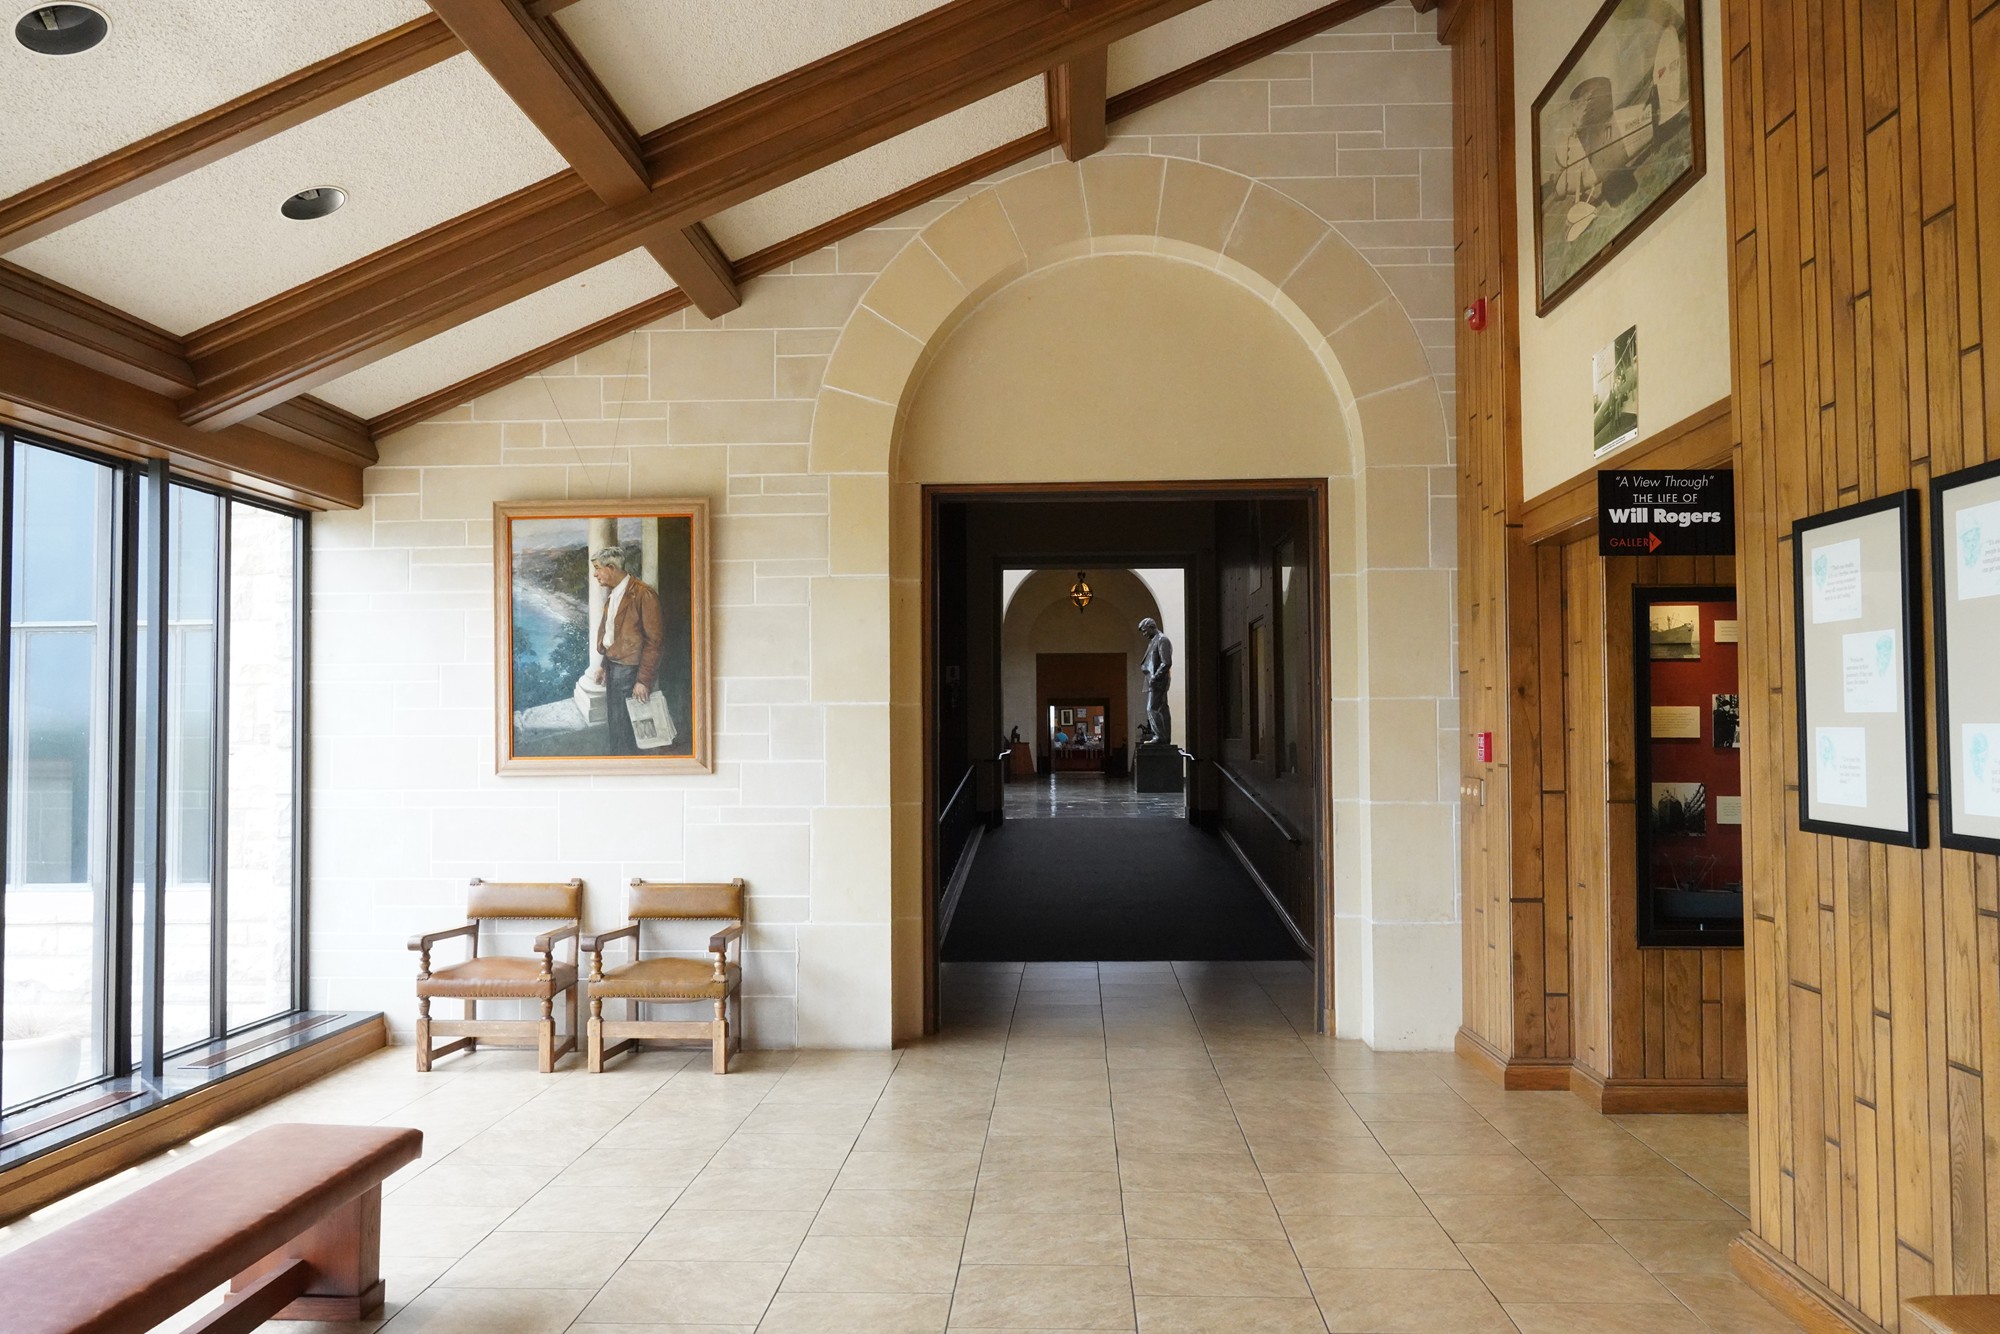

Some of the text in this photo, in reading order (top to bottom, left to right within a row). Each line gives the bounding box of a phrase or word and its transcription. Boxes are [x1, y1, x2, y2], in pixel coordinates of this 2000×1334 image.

[1633, 476, 1661, 487] View
[1633, 493, 1698, 503] THE LIFE OF
[1608, 507, 1721, 527] Will Rogers
[1609, 538, 1656, 547] GALLERY
